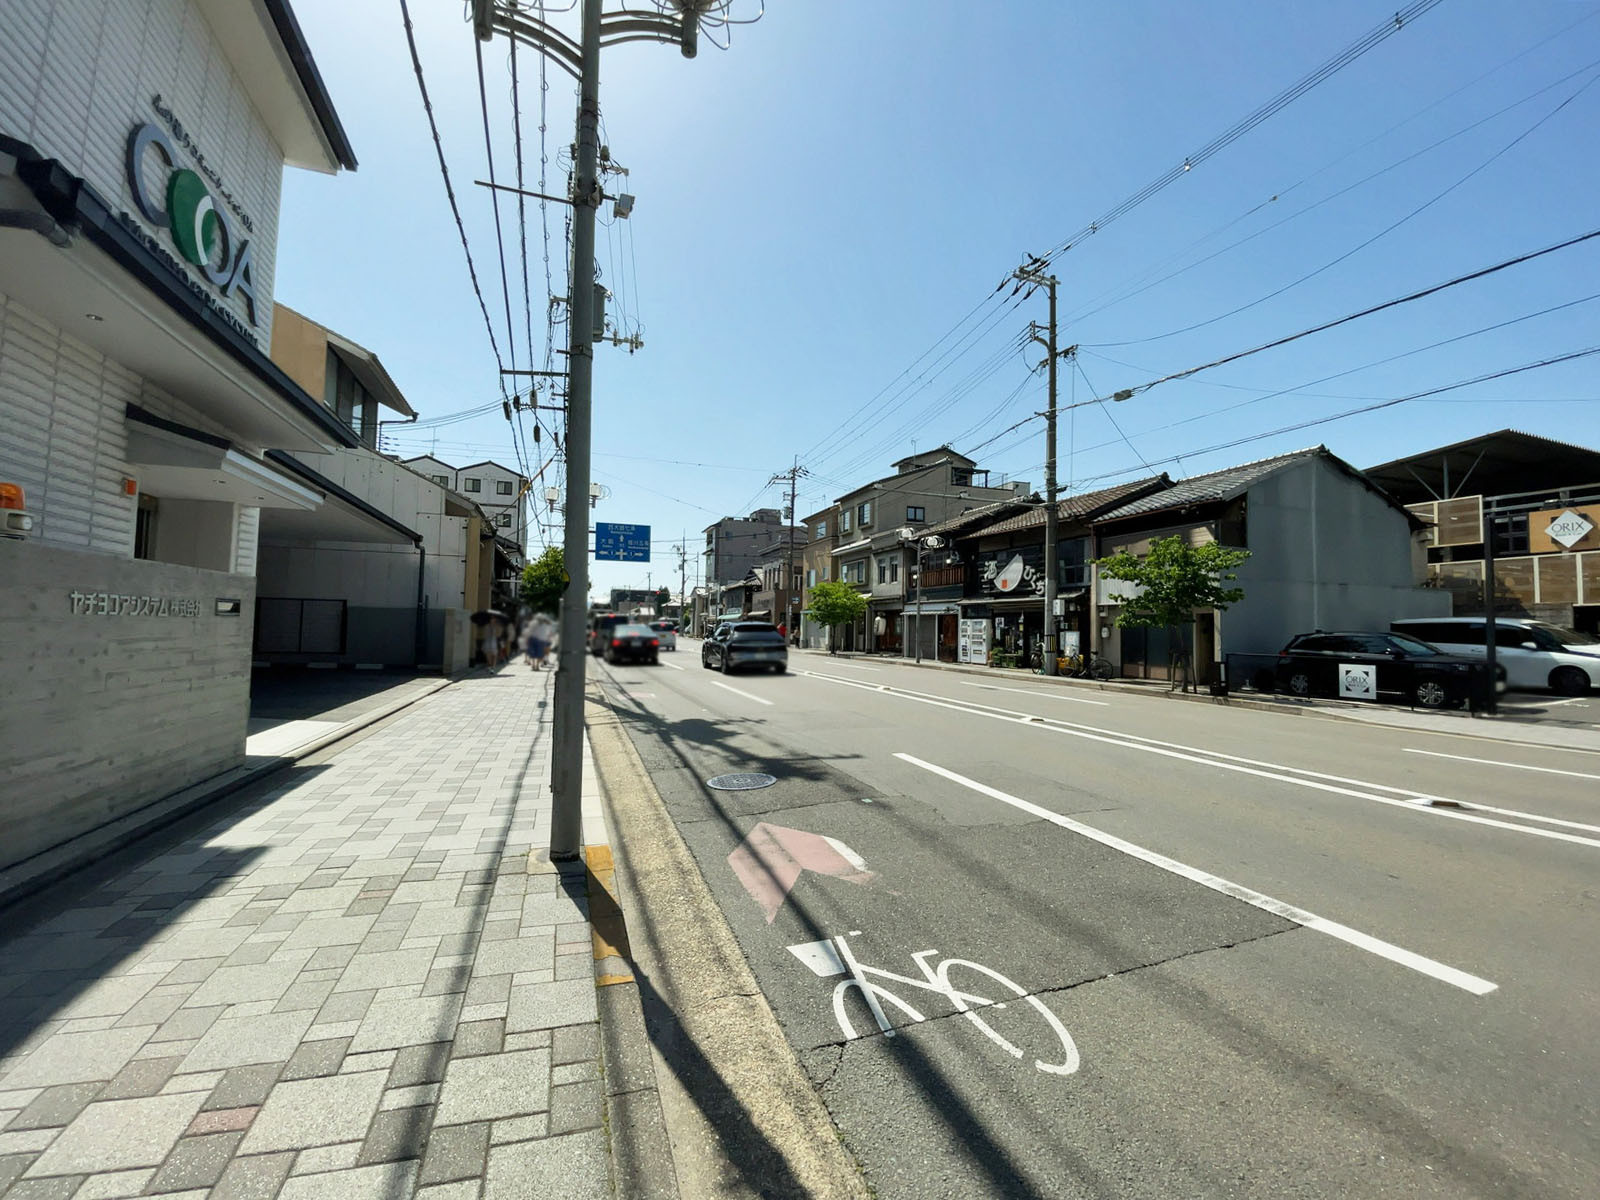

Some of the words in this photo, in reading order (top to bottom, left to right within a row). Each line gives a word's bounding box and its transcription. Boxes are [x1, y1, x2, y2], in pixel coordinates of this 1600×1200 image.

[1551, 520, 1585, 533] ORIX
[983, 560, 998, 580] 酒
[1345, 675, 1369, 686] ORIX
